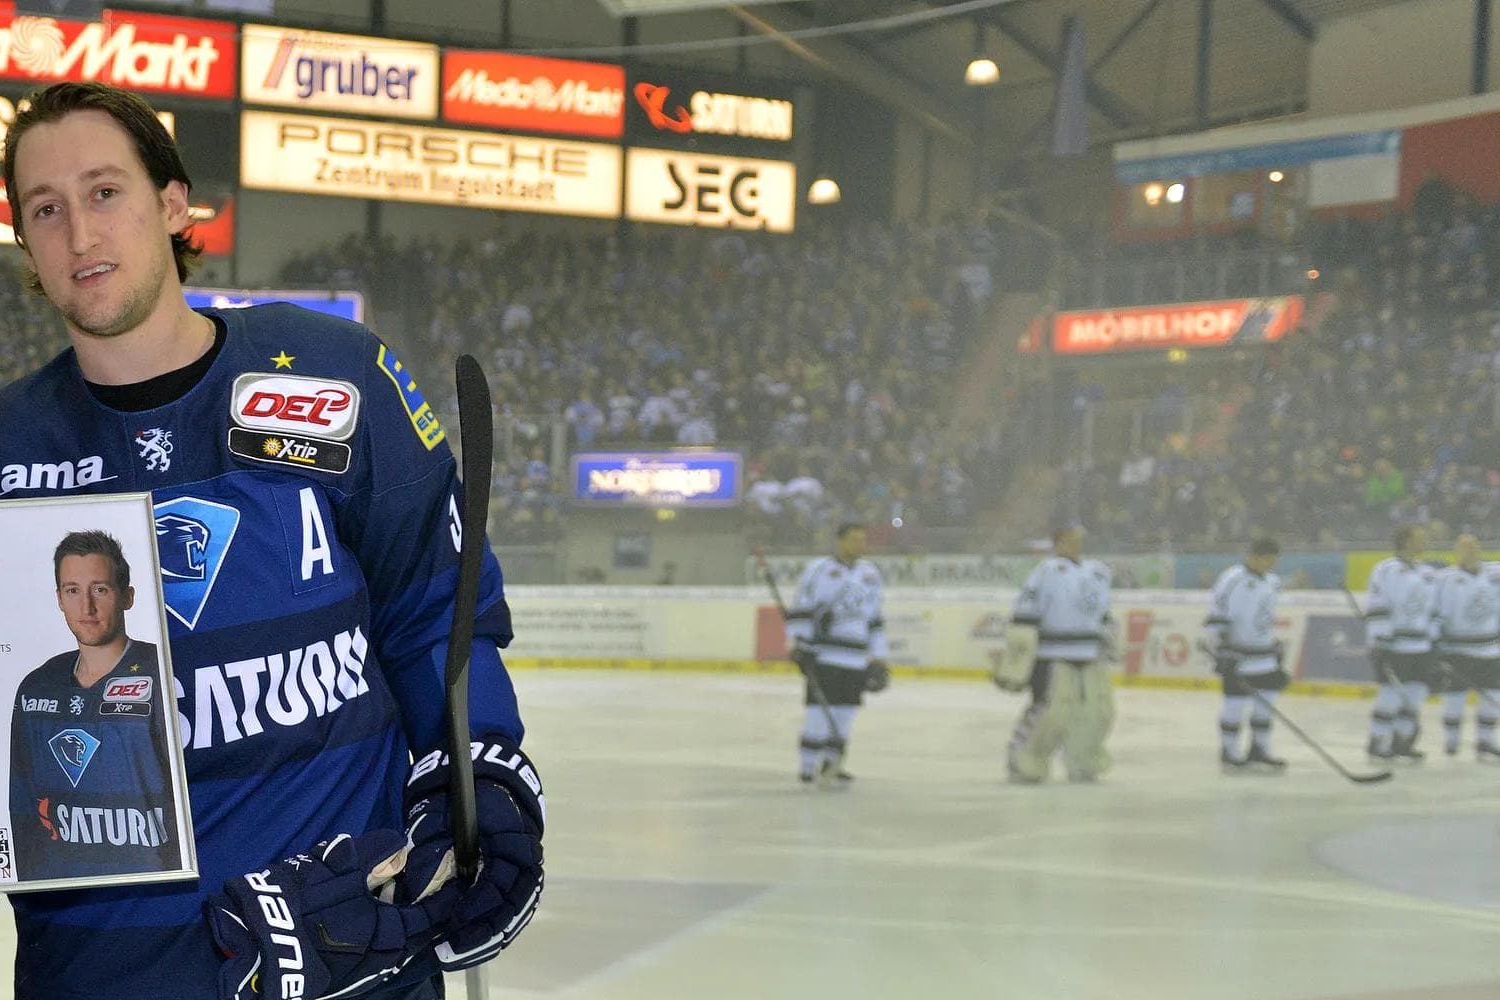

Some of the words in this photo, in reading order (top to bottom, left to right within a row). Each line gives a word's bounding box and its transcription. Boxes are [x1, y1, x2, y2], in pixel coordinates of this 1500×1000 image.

[296, 53, 418, 100] gruber
[278, 121, 588, 178] PORSCHE
[315, 158, 422, 190] Zentrum
[241, 389, 351, 427] DEL
[300, 487, 334, 581] A
[57, 804, 169, 848] SATURN
